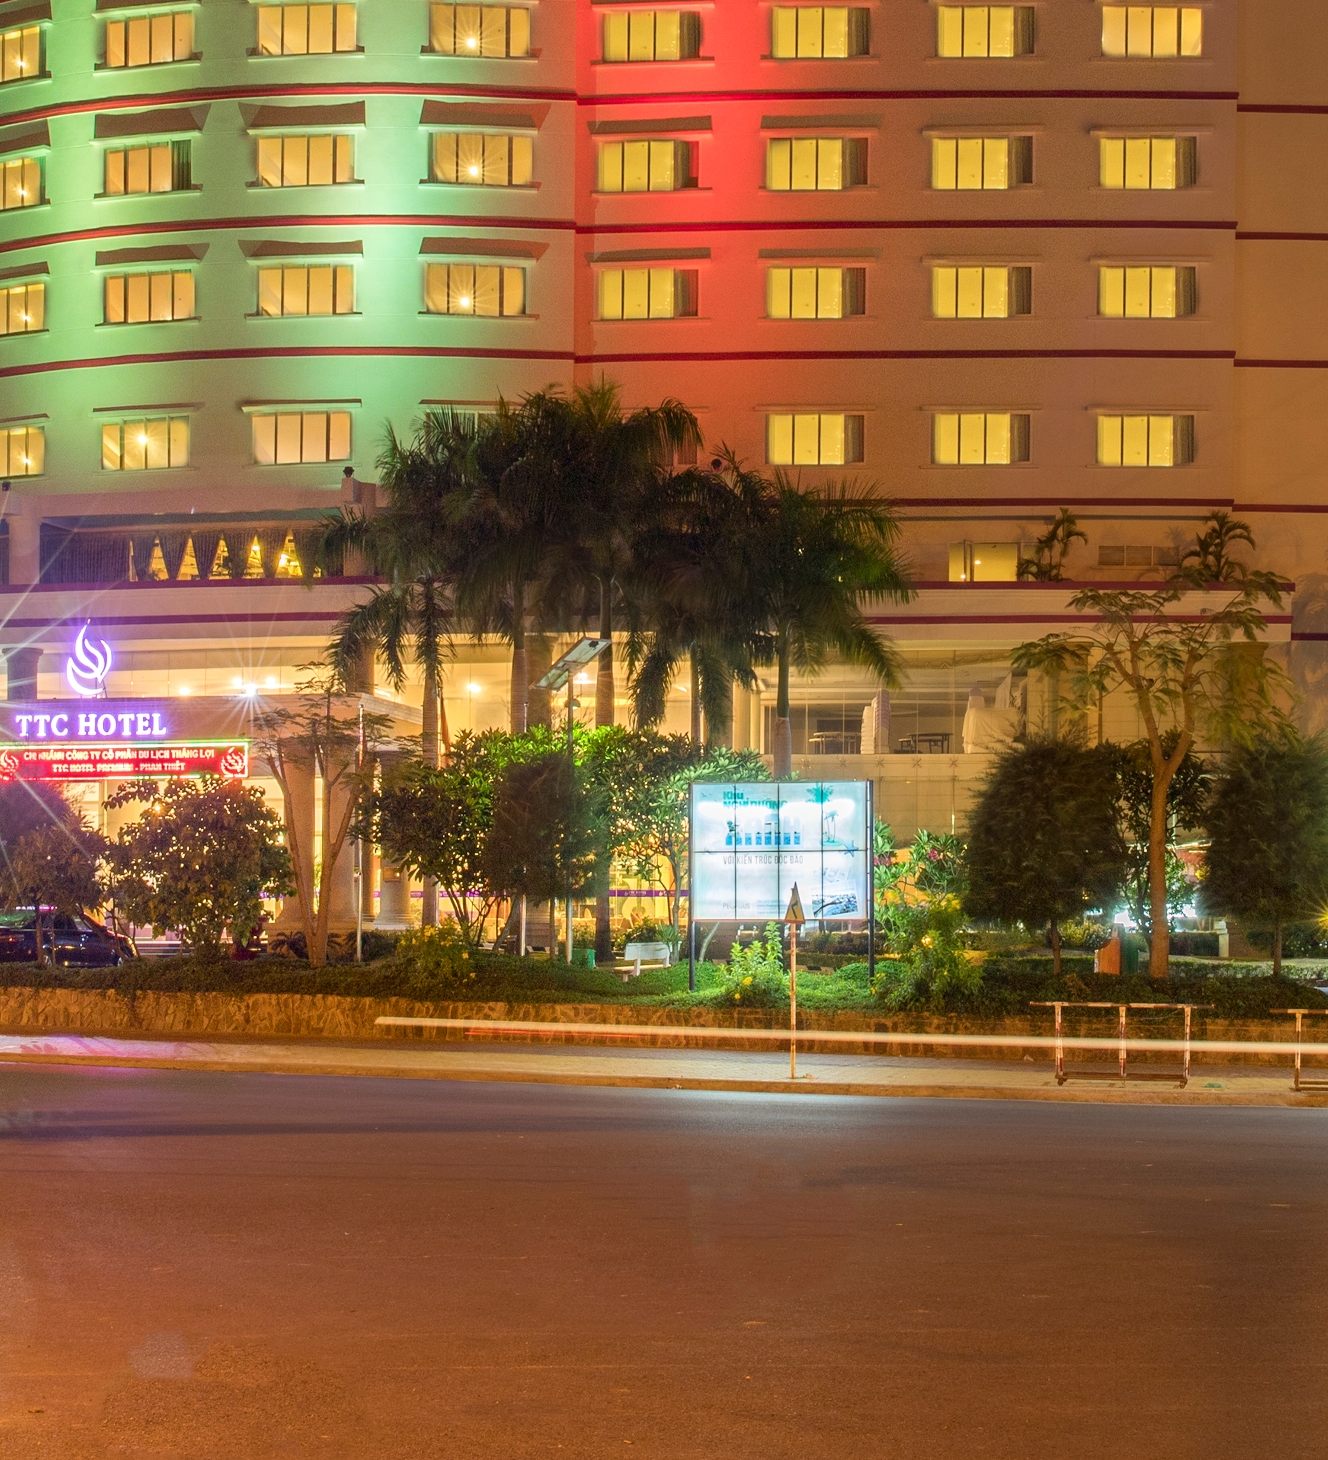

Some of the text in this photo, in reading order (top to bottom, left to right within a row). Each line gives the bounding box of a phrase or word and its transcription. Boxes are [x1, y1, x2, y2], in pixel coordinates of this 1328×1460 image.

[16, 712, 167, 737] TTC HOTEL
[90, 751, 101, 760] TY
[138, 750, 150, 759] DU
[52, 763, 69, 772] TTC
[722, 791, 744, 800] Khu
